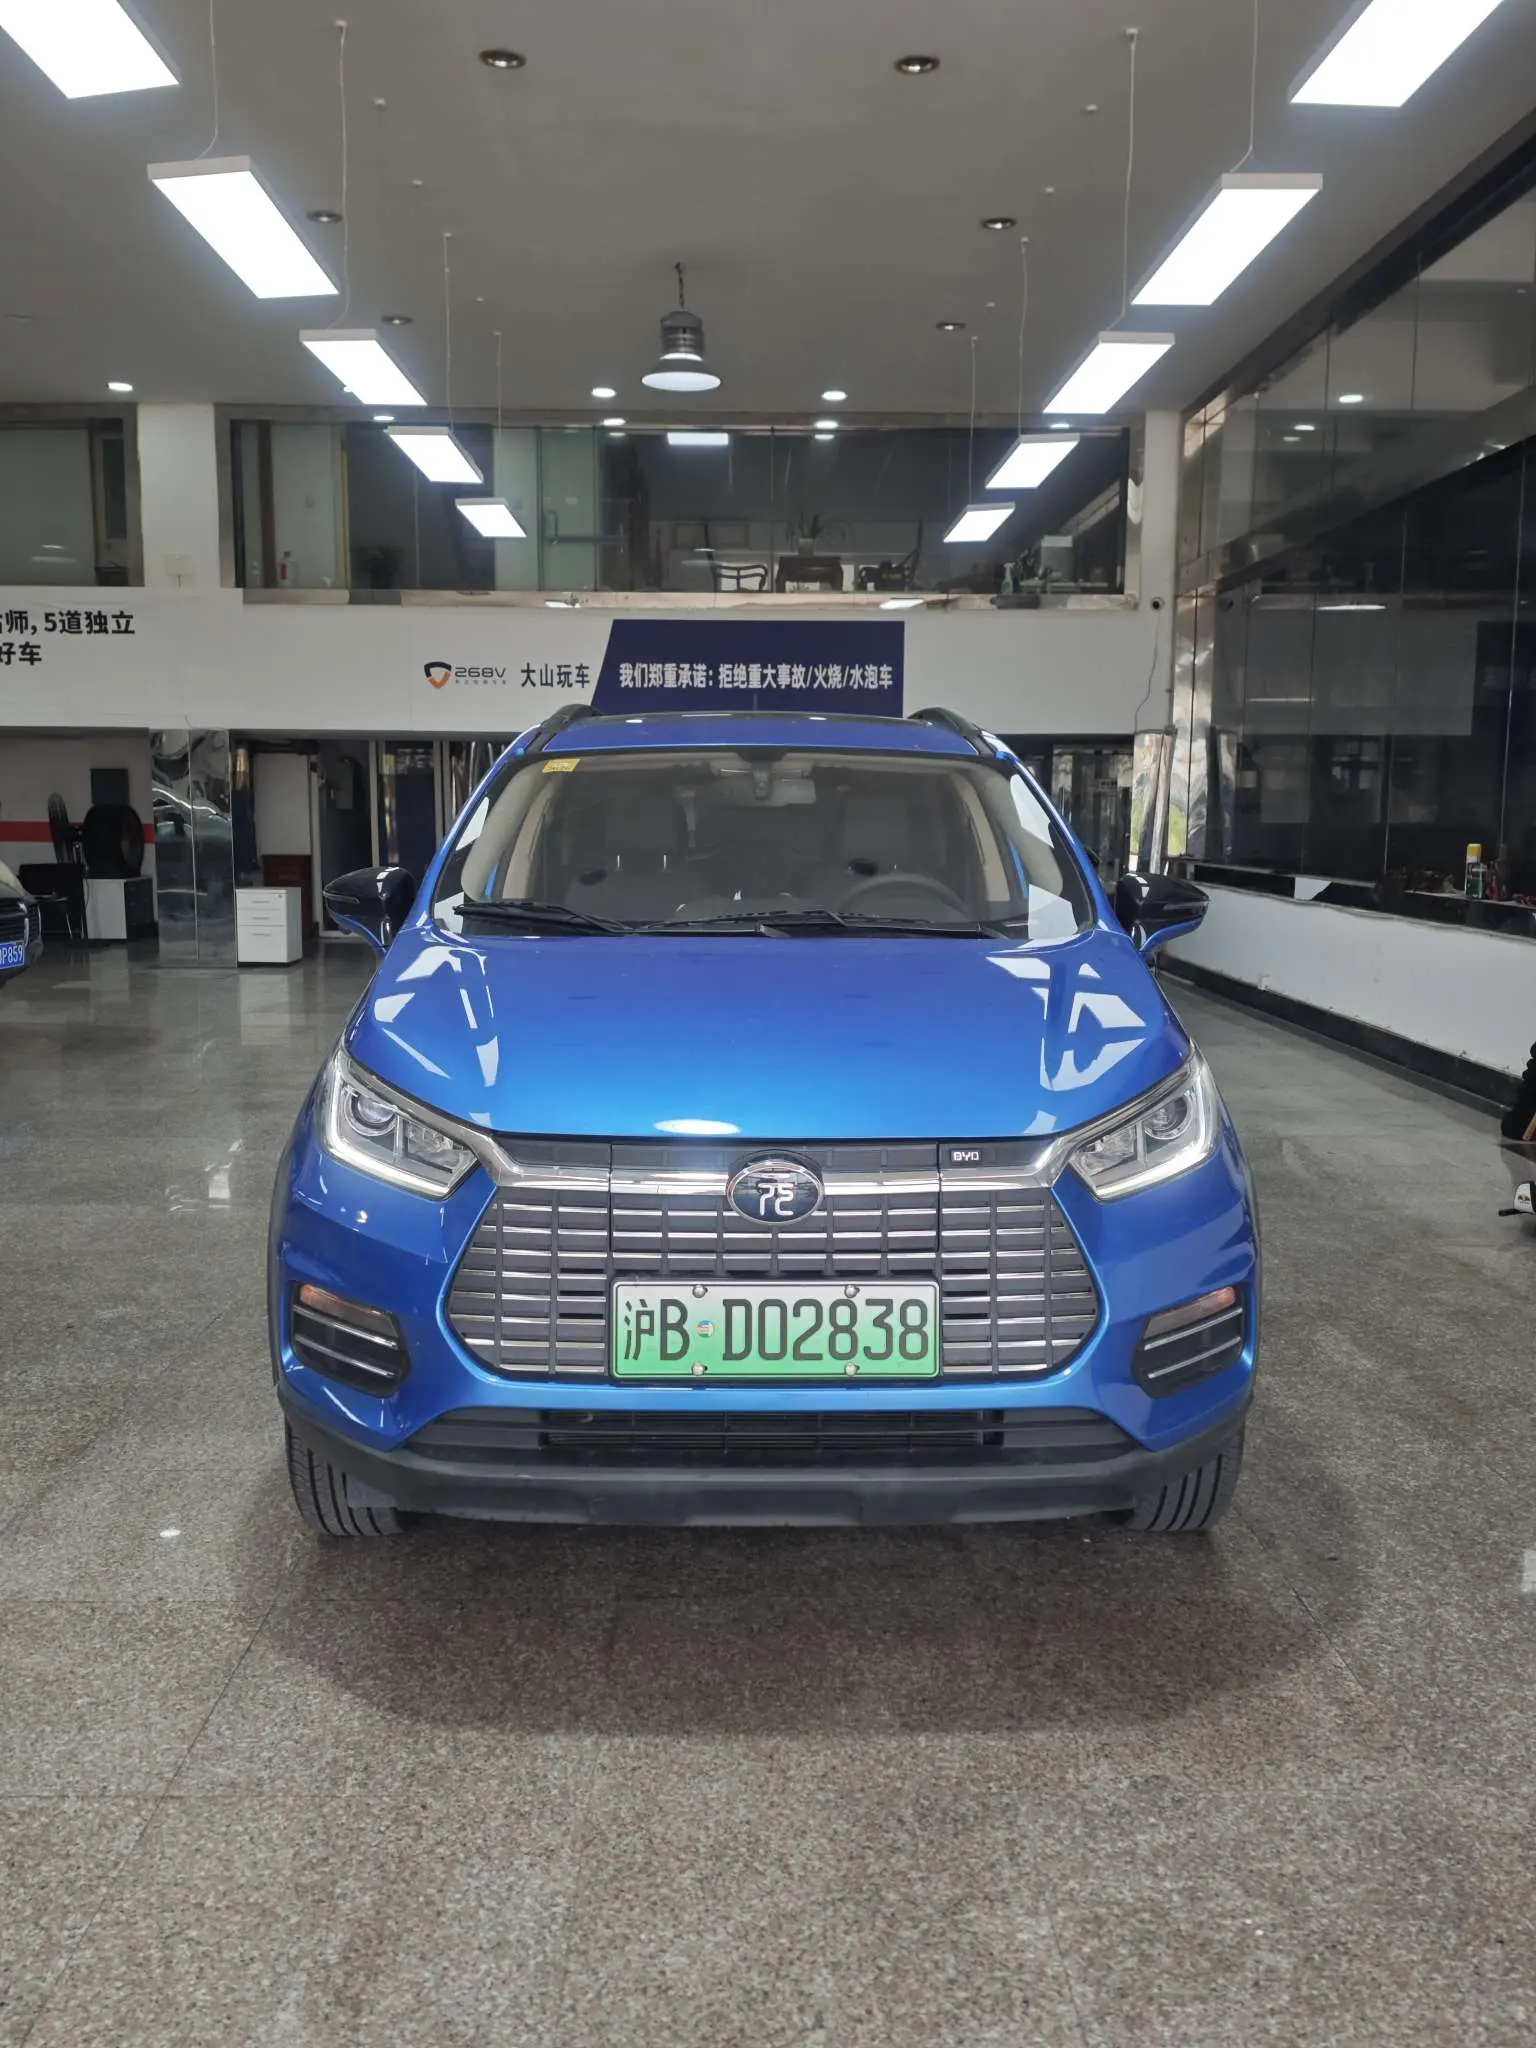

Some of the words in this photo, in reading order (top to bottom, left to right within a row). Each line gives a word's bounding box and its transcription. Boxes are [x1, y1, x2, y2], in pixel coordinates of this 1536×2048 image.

[0, 610, 135, 636] 师,5道独立
[454, 667, 506, 679] 268V
[521, 662, 590, 689] 大山玩车
[0, 944, 23, 965] P859
[953, 1151, 980, 1161] BYD
[722, 1298, 929, 1361] D02838
